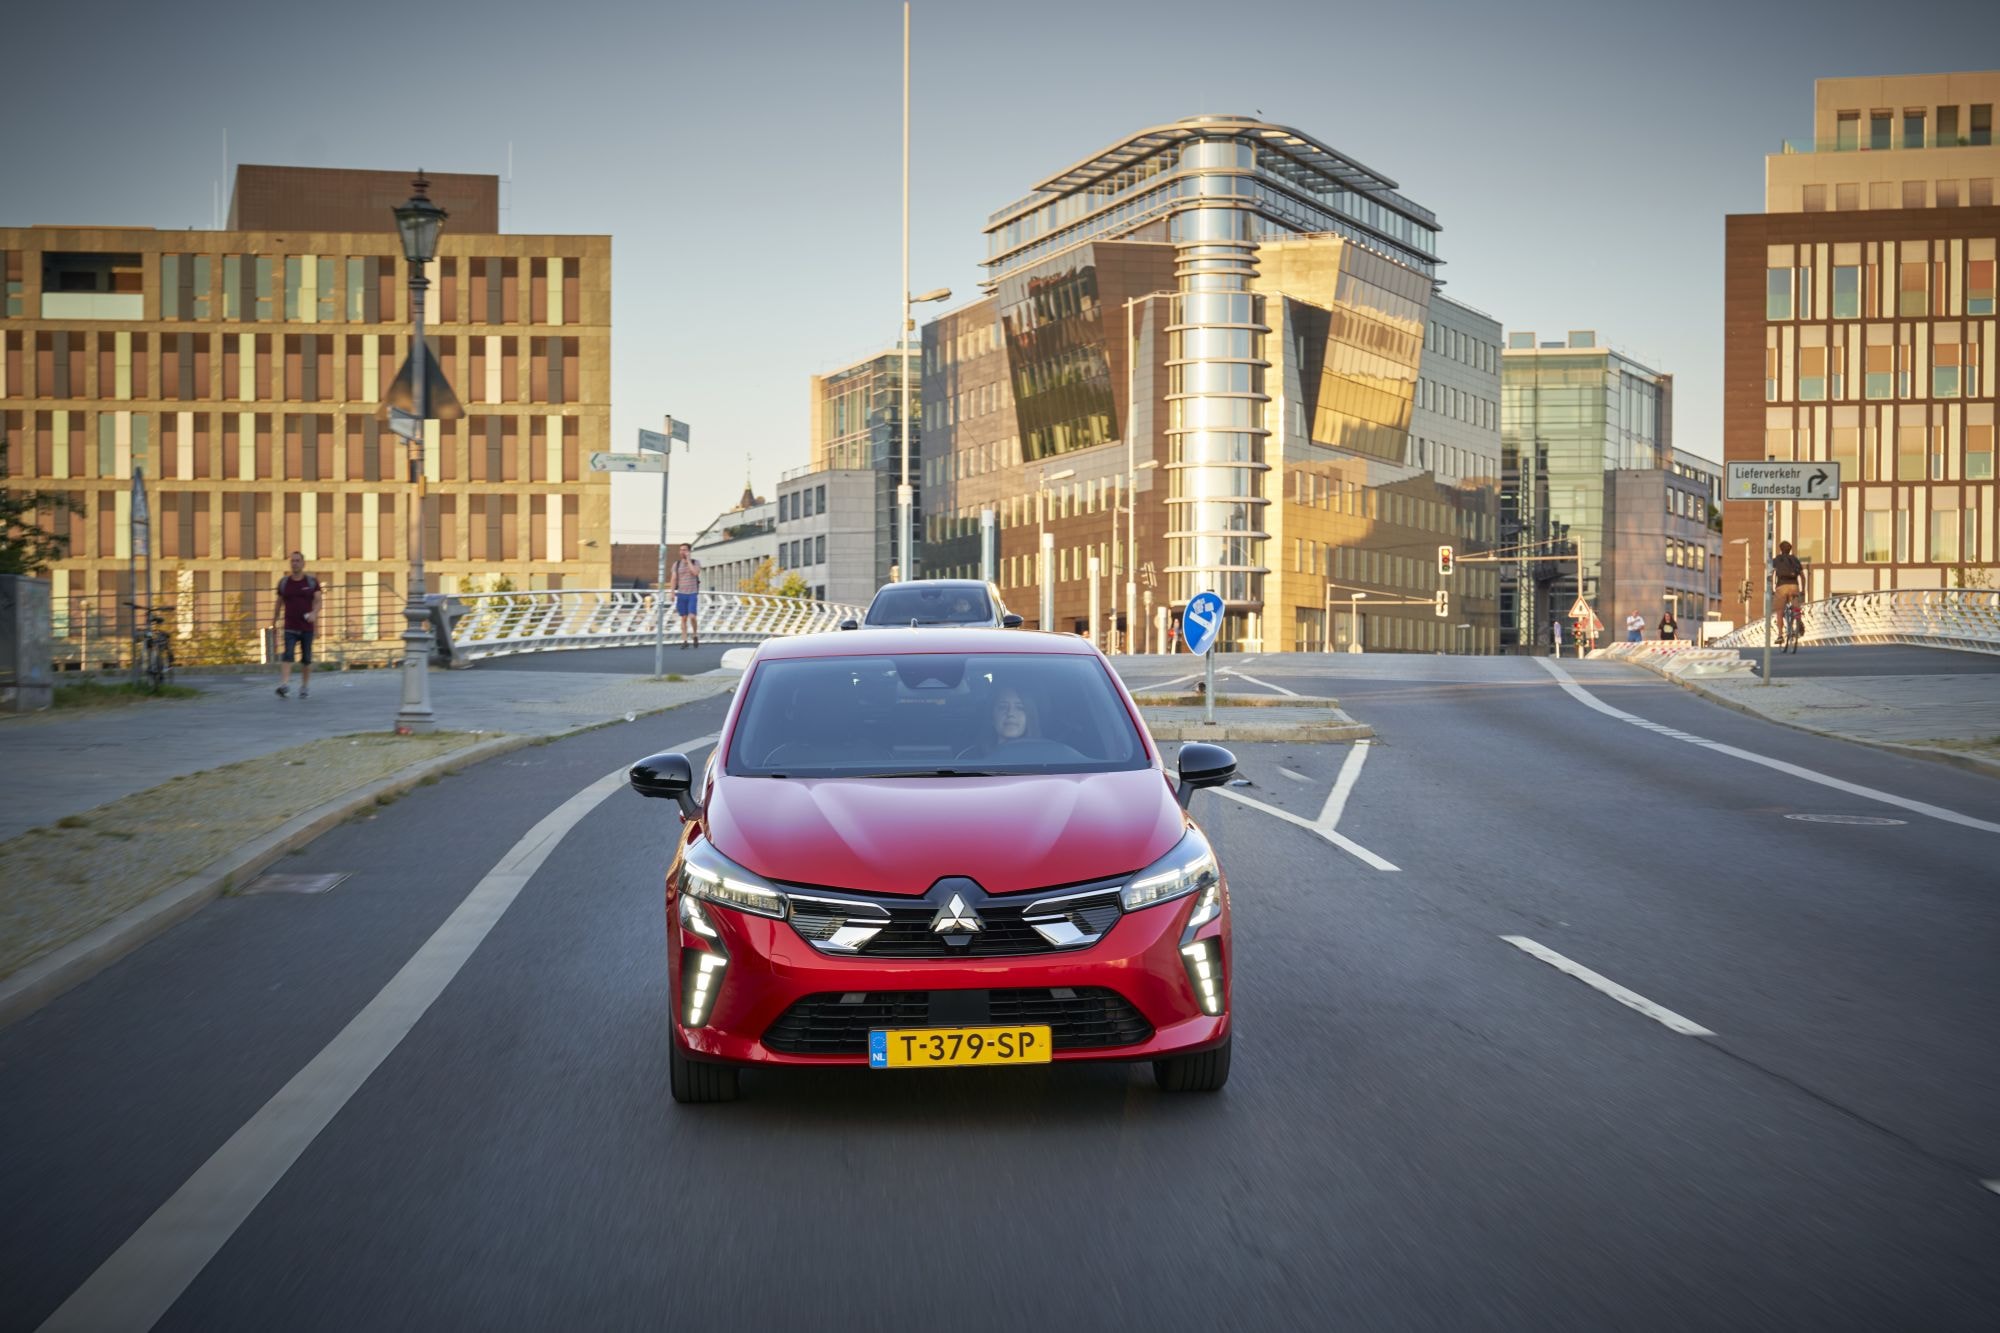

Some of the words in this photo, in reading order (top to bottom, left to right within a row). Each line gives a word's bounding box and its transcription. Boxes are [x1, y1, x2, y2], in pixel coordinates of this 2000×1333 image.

[1736, 468, 1801, 479] Lieferverkehr
[1751, 483, 1801, 497] Bundestag
[900, 1032, 1035, 1061] T-379-SP
[872, 1053, 886, 1062] NL
